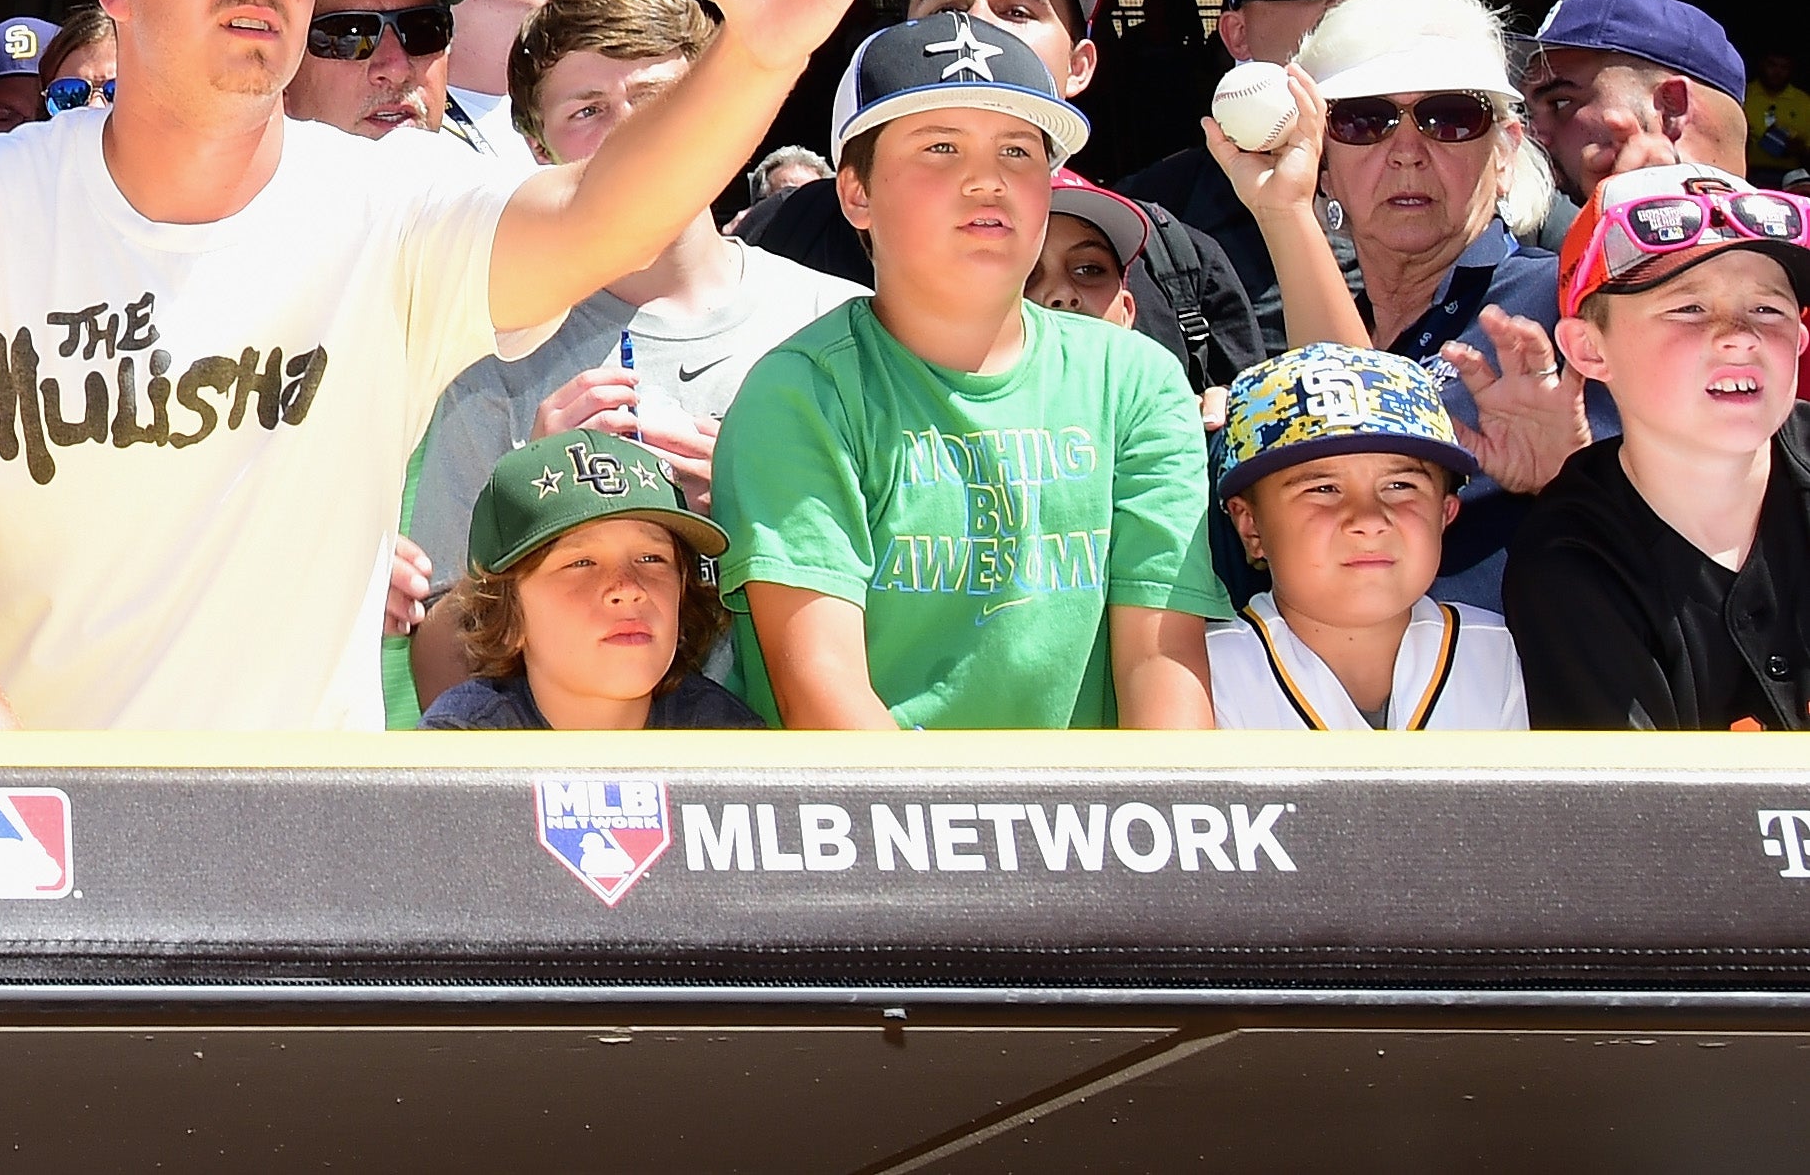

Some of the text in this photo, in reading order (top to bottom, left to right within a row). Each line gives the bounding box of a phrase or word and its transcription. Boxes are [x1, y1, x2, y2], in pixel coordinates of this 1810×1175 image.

[4, 24, 38, 59] SD
[47, 291, 160, 360] THE
[1301, 358, 1368, 429] SD
[565, 442, 630, 498] LC
[542, 780, 660, 816] MLB
[546, 816, 661, 830] NETWORK
[684, 801, 1297, 874] MLB NETWORK
